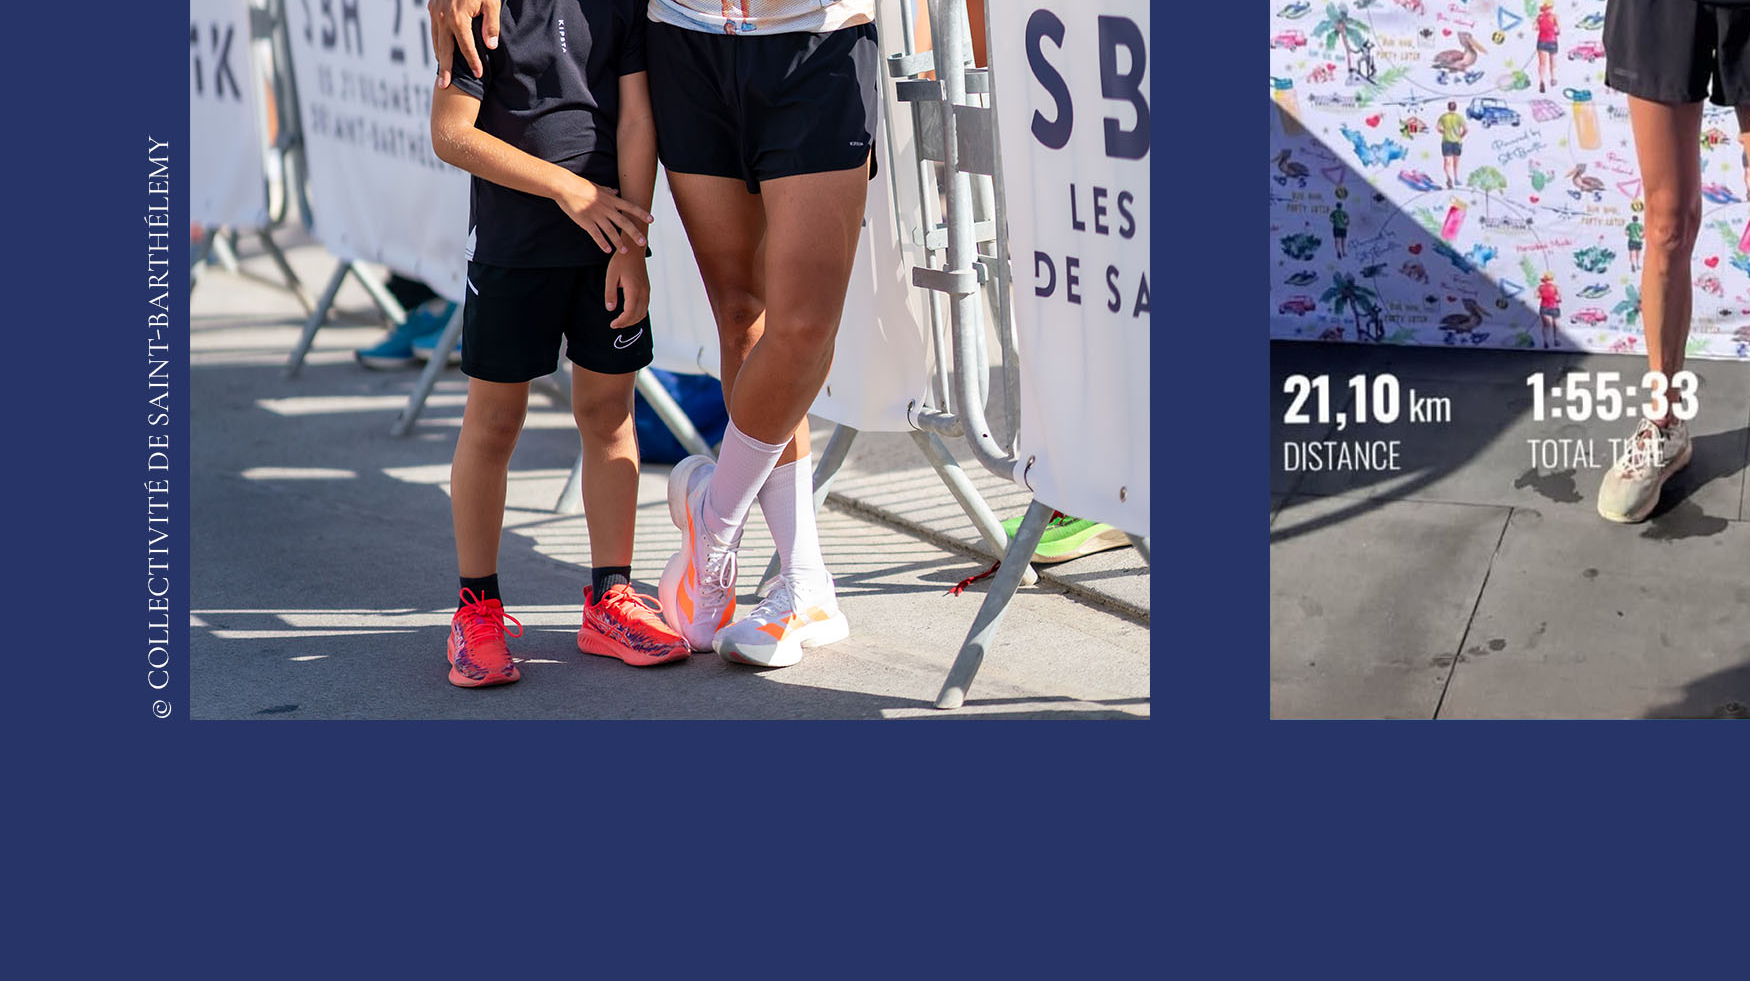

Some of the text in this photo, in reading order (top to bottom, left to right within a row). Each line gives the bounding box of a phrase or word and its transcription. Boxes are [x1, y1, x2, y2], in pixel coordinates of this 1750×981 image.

[558, 19, 567, 53] KIPSTA
[1070, 183, 1136, 240] LES
[1034, 250, 1082, 306] DE
